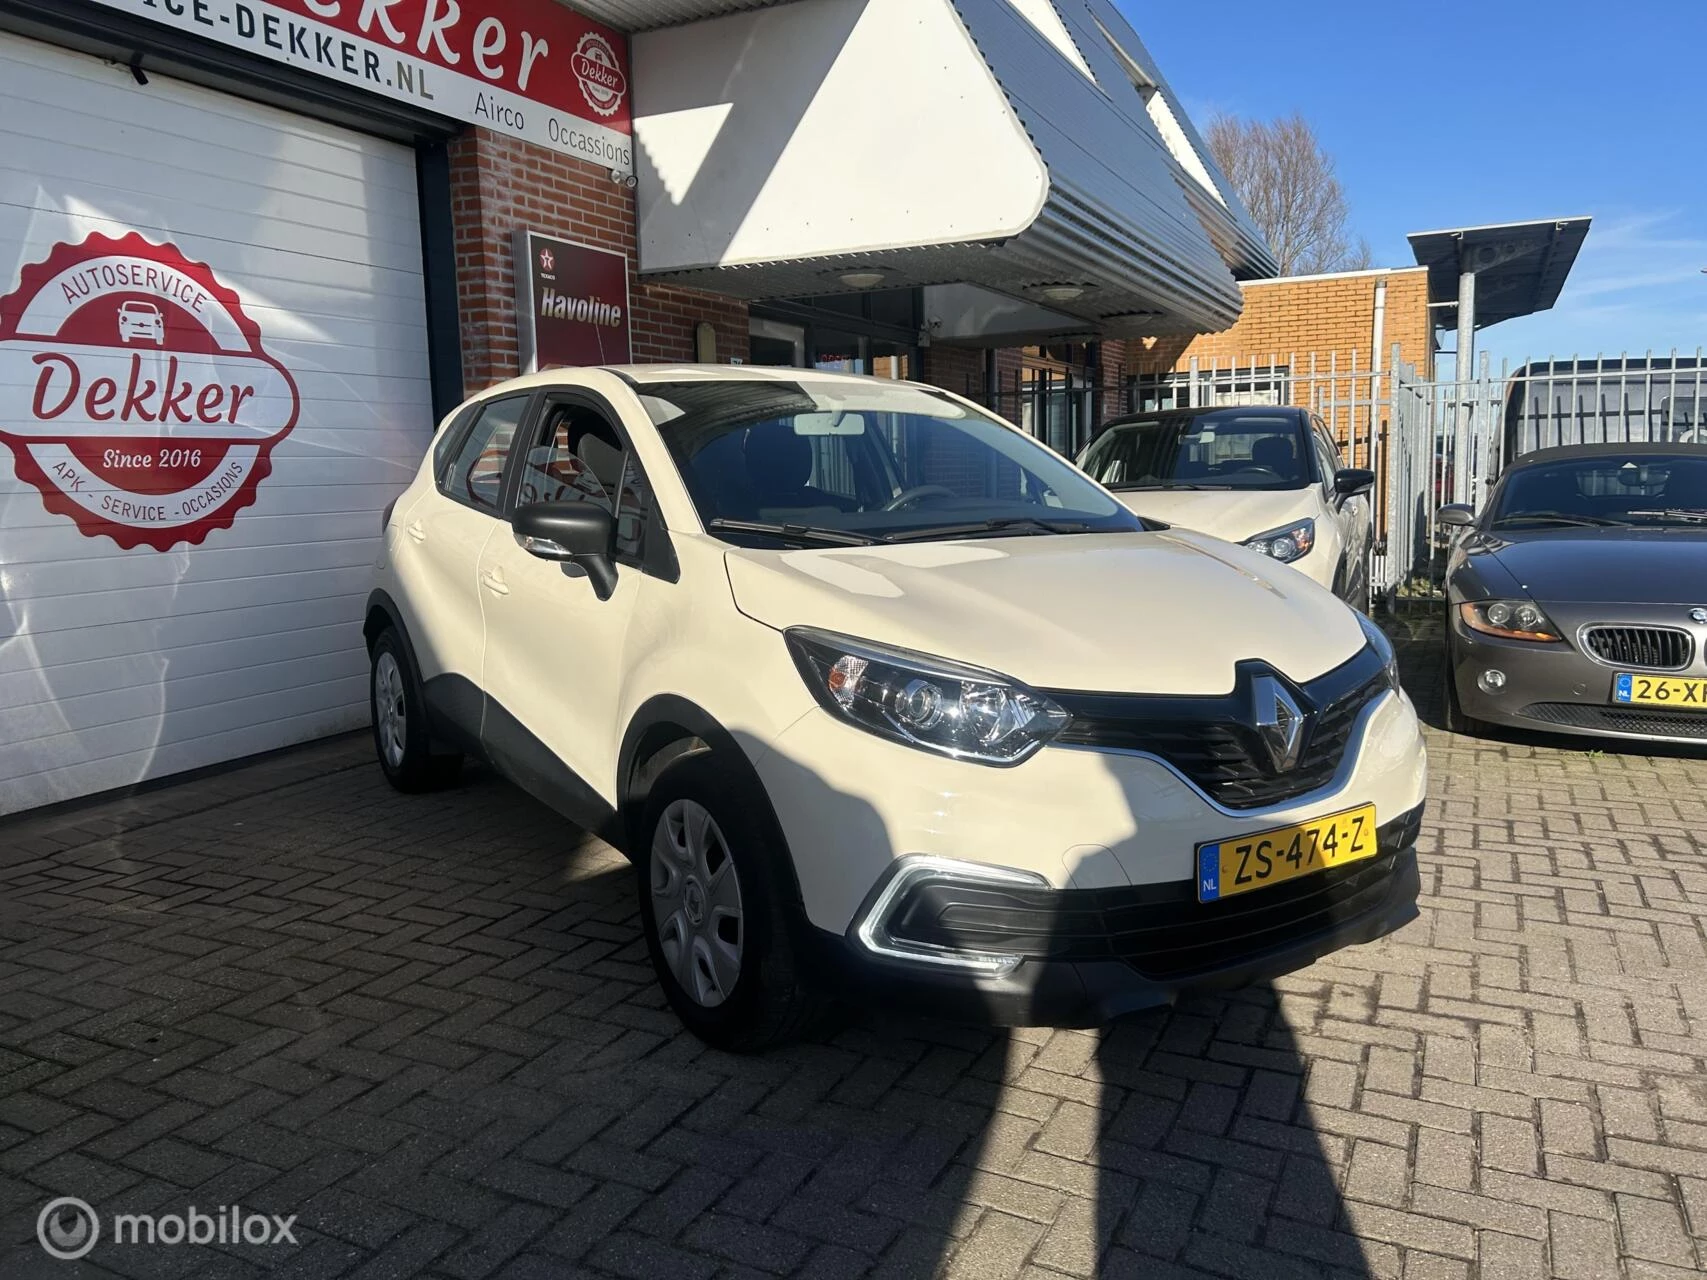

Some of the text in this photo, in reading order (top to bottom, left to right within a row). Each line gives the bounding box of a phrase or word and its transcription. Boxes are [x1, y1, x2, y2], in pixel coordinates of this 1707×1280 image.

[142, 0, 434, 101] E-DEKKER.NL
[304, 0, 549, 91] ker
[581, 58, 618, 88] Dekker
[474, 92, 630, 166] Airco Occassions
[60, 263, 207, 314] AUTOSERVICE
[541, 286, 622, 328] Havoline
[31, 352, 255, 424] Dekker
[103, 449, 201, 468] Since 2016
[52, 461, 86, 493] APK
[101, 495, 167, 521] SERVICE
[182, 462, 243, 516] OCCASIONS
[1234, 816, 1365, 885] ZS-474-Z
[1203, 878, 1217, 892] NL
